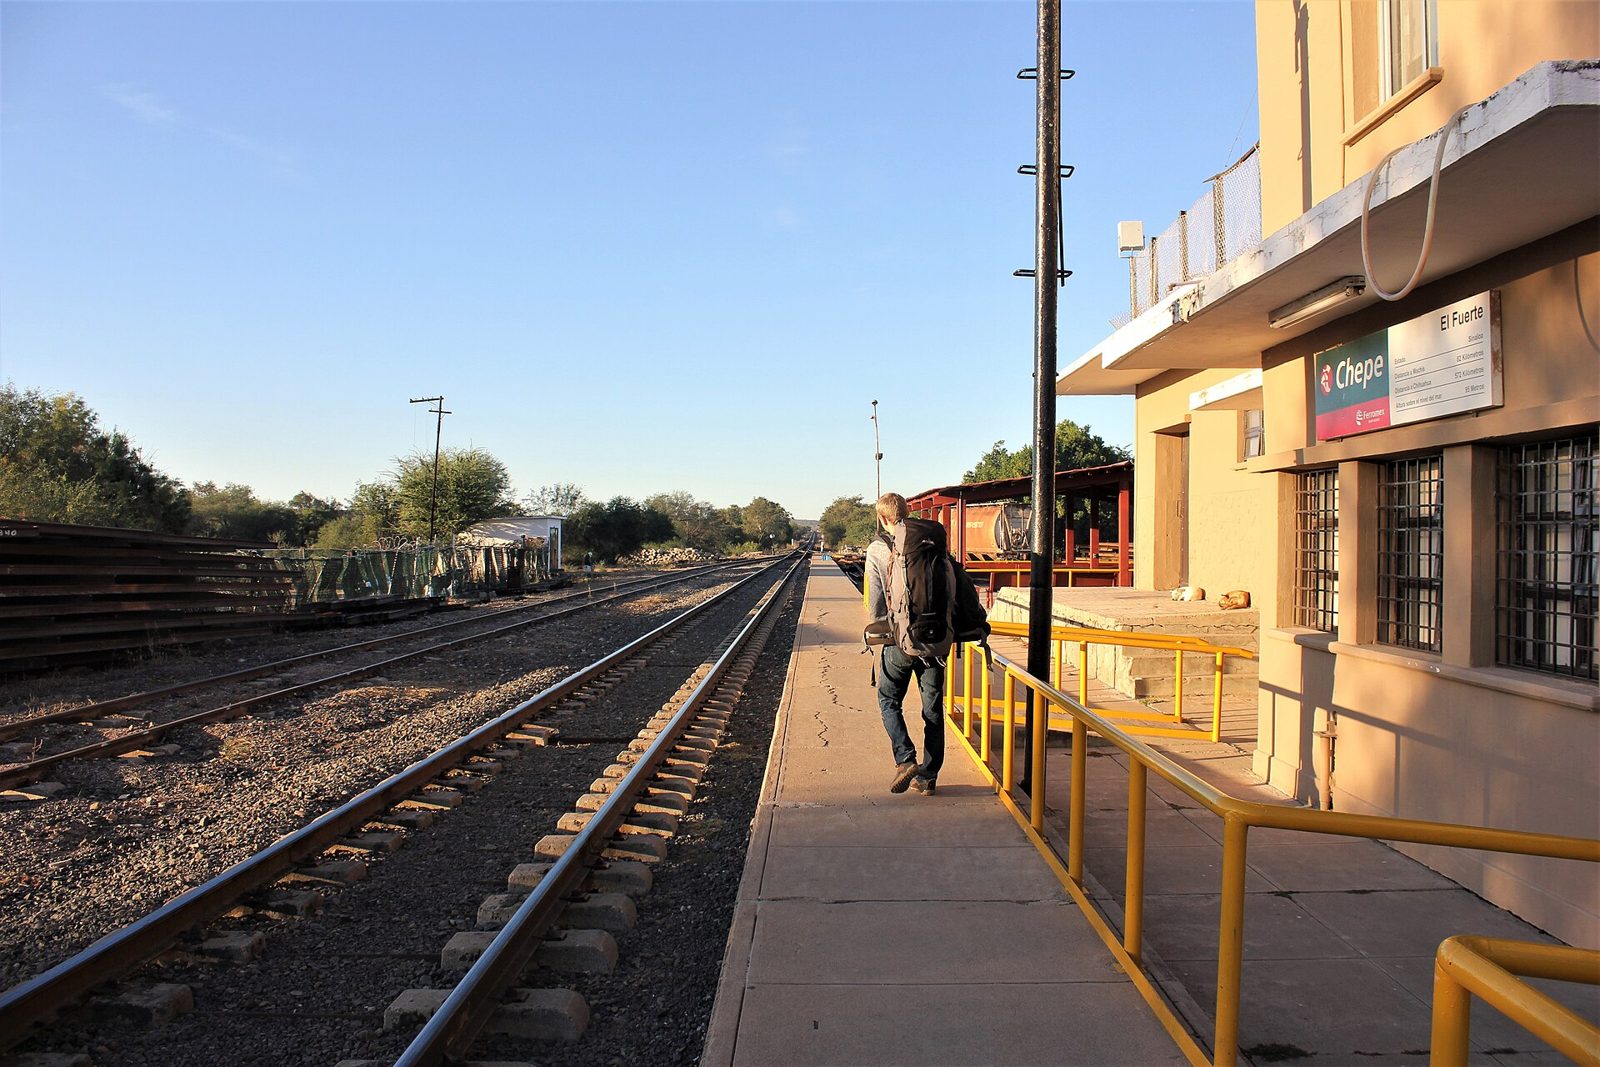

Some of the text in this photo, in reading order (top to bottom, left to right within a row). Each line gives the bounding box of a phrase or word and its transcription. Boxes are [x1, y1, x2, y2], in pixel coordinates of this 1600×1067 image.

[1440, 305, 1484, 332] El Fuerte
[1468, 332, 1484, 343] Sinaloa
[1335, 354, 1384, 389] Chepe
[1363, 409, 1385, 420] Ferromex
